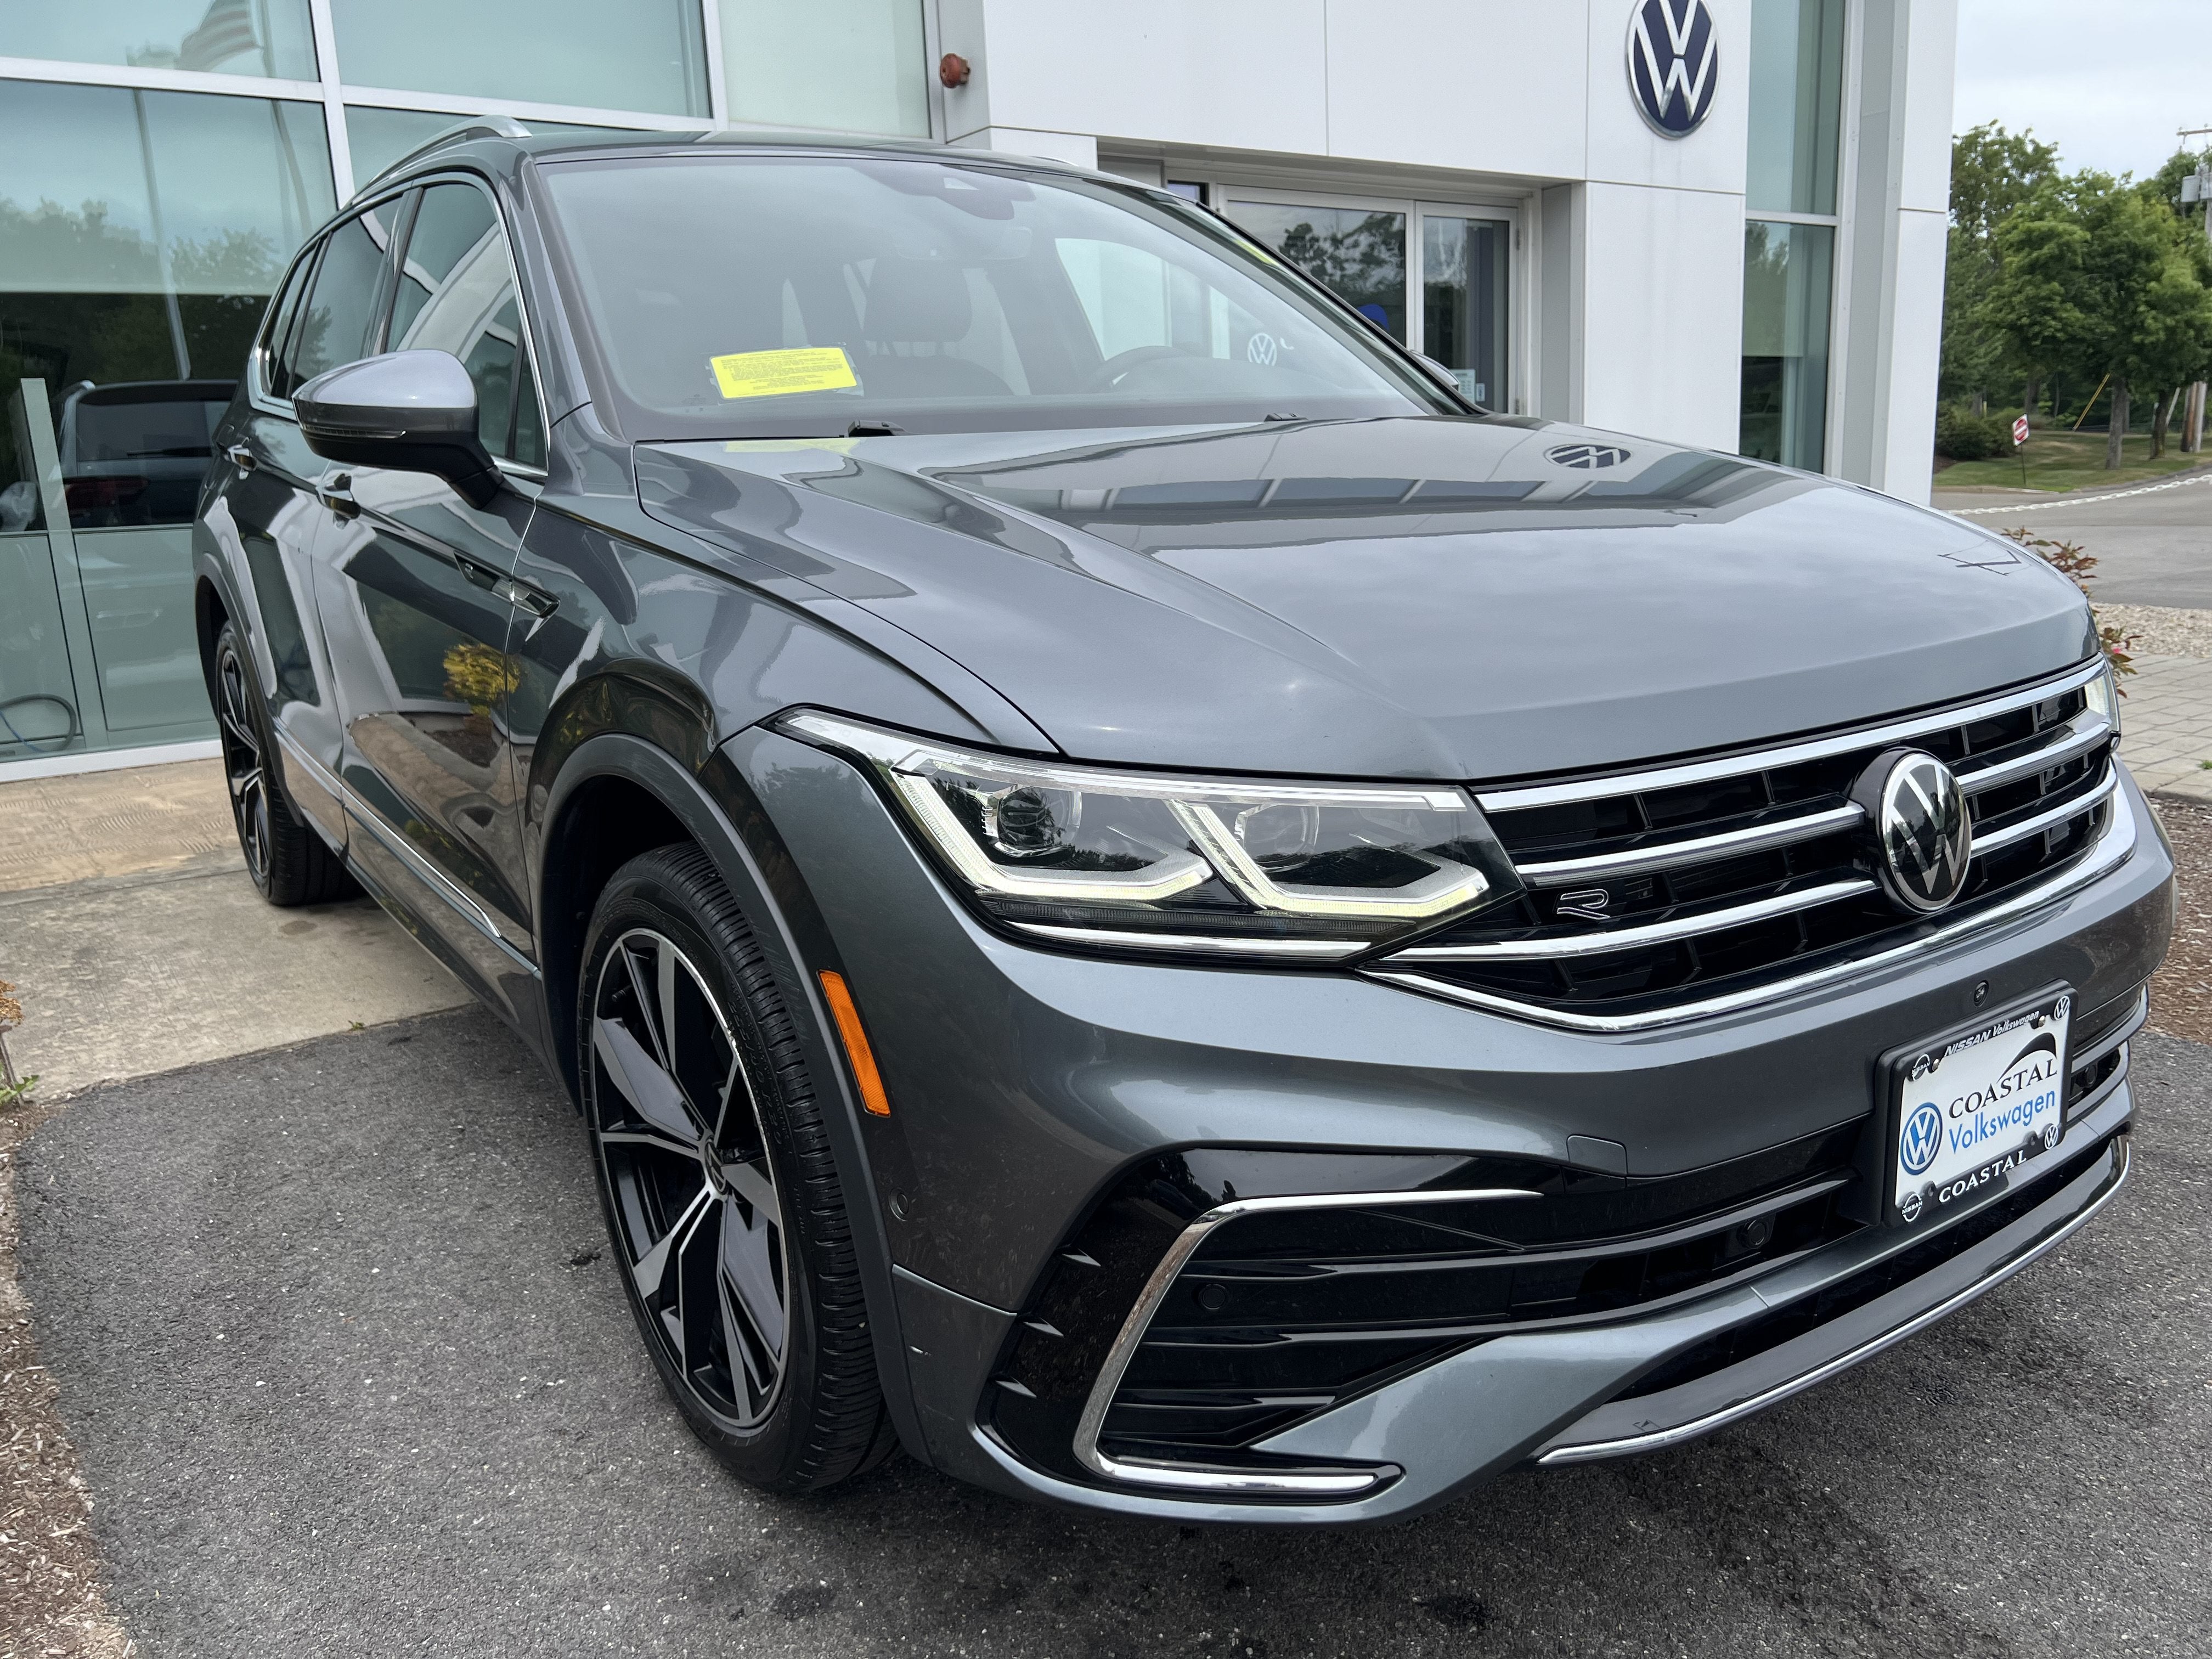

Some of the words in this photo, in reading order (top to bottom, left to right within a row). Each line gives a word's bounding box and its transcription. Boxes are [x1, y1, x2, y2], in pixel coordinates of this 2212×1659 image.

[1885, 756, 1968, 906] VW
[1556, 888, 1611, 921] R
[1944, 1029, 1991, 1057] NISSAN
[1993, 1011, 2040, 1037] Volkswagen
[1949, 1058, 2058, 1119] COASTAL
[1901, 1104, 1942, 1173] VW
[1949, 1090, 2056, 1154] Volkswagen
[1939, 1150, 2027, 1203] COASTAL
